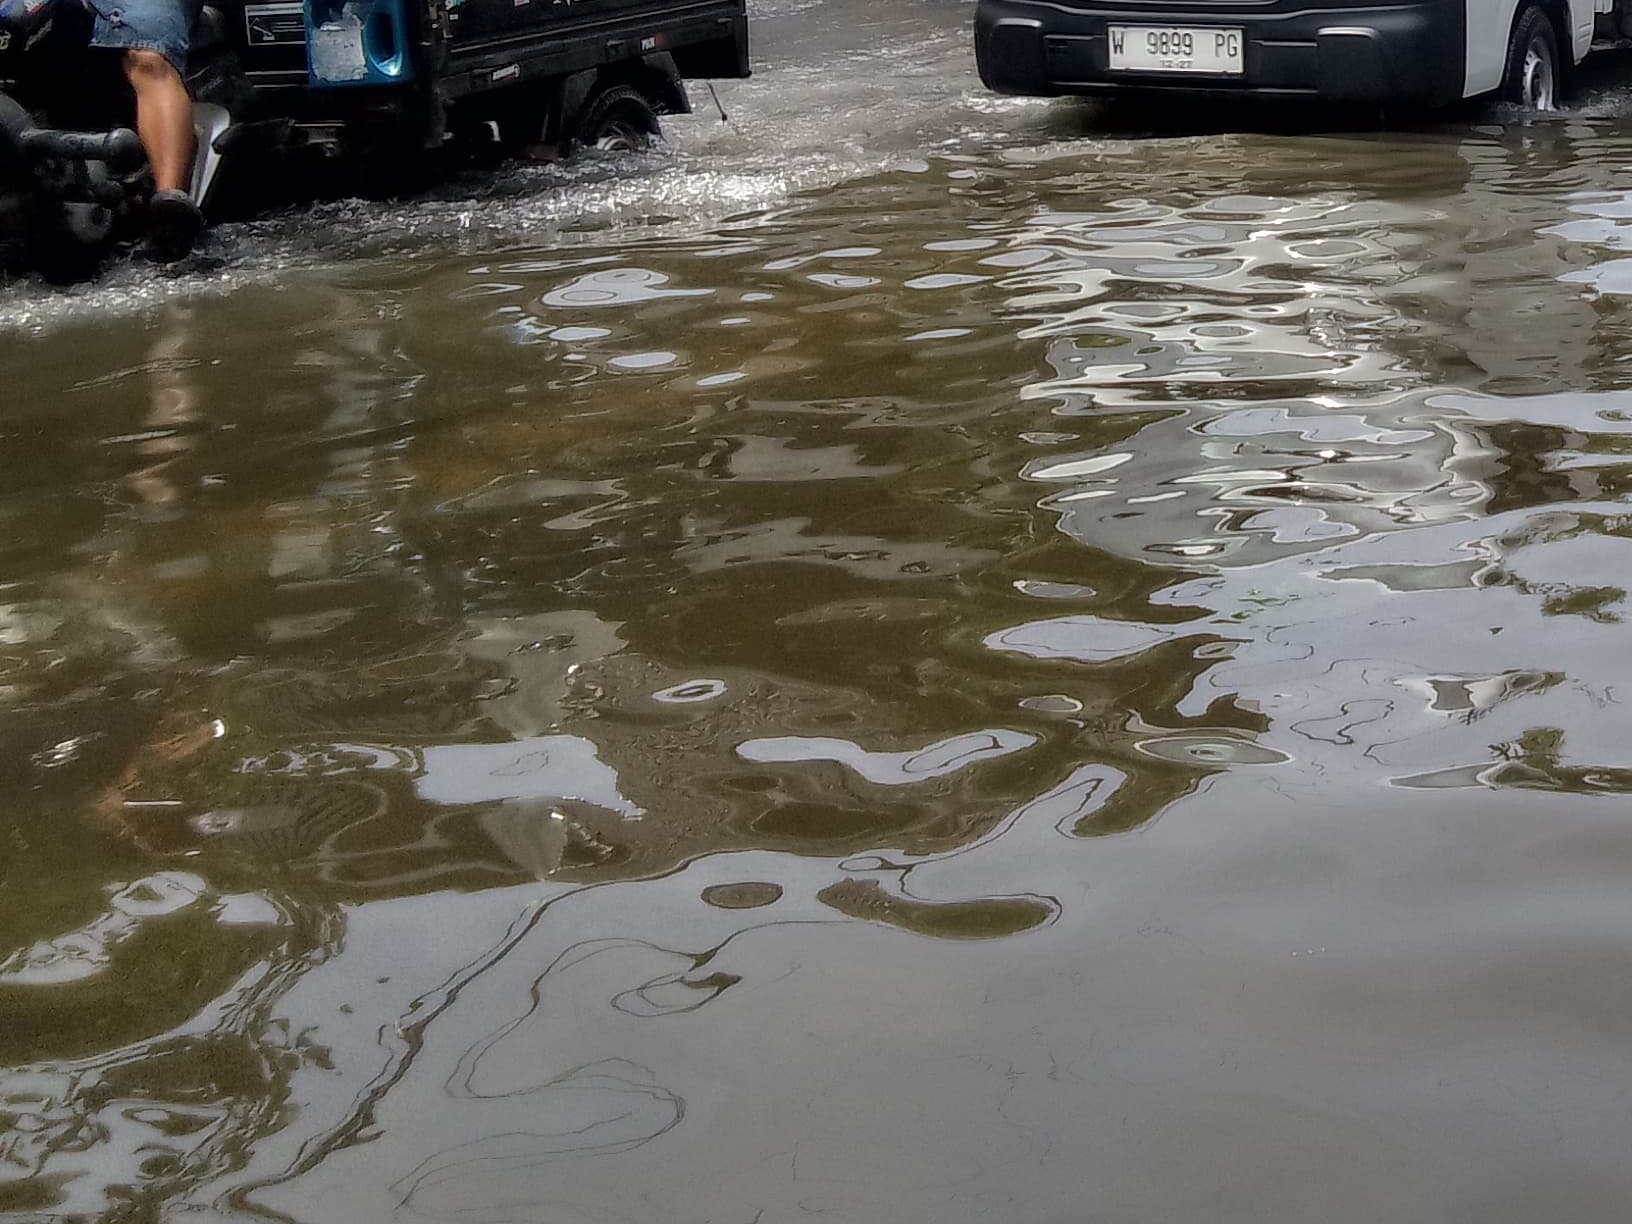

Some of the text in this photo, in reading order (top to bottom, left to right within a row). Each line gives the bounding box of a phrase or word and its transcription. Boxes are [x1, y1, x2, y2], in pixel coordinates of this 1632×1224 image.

[1112, 30, 1238, 58] W 9899 PG
